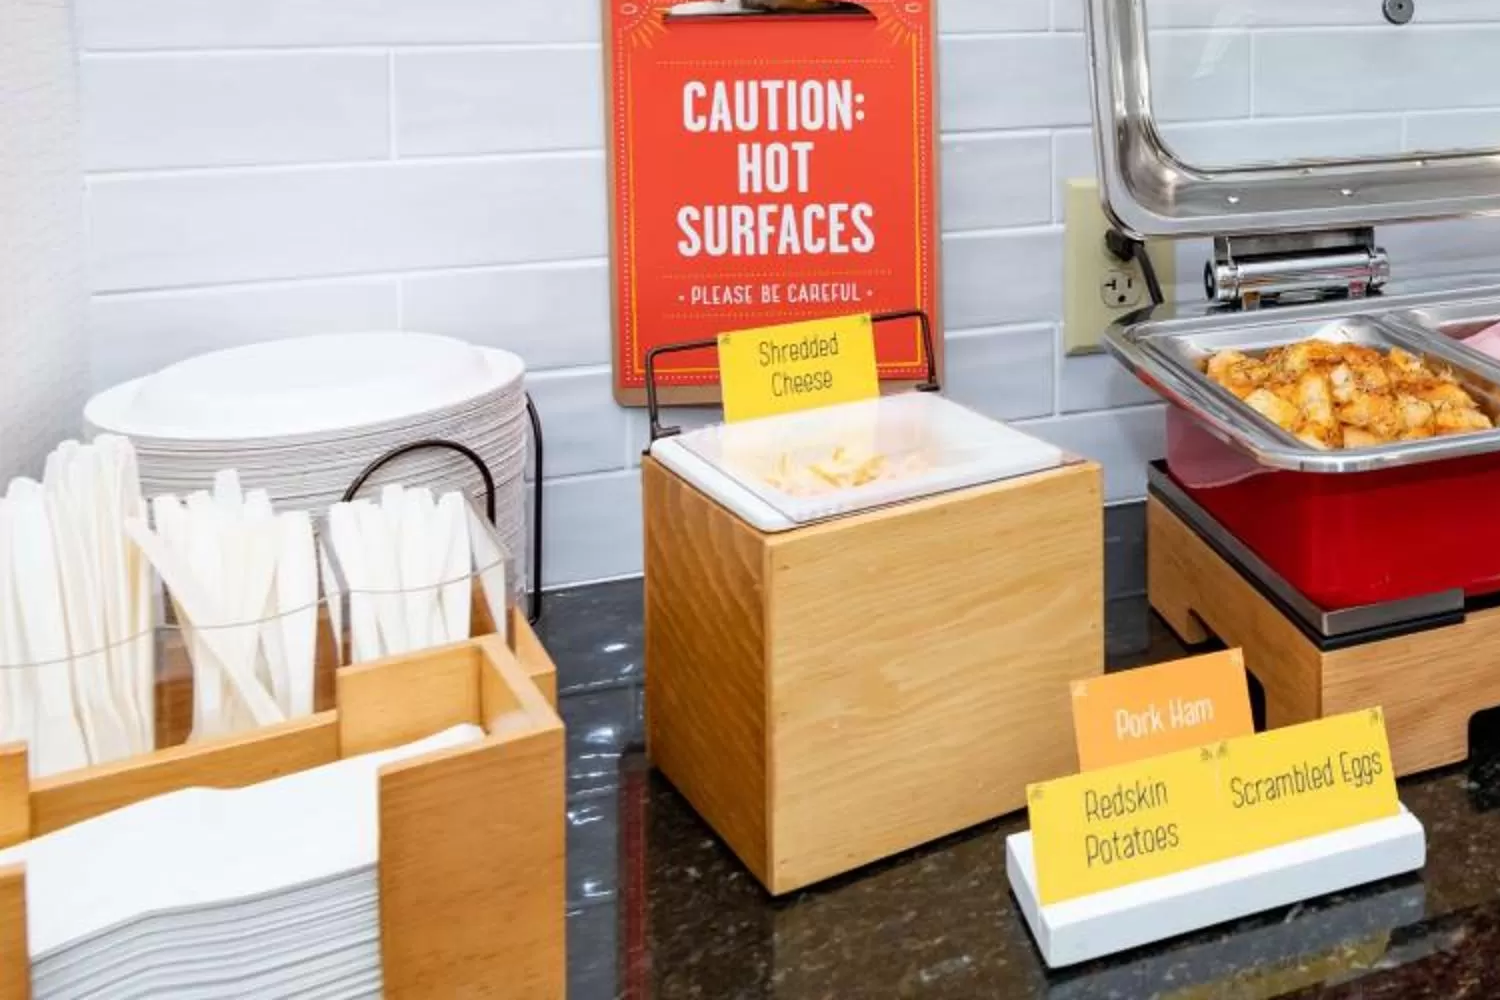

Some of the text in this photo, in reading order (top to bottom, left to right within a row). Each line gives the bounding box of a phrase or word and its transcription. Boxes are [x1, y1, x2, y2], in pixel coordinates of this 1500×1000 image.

[682, 79, 865, 132] CAUTION:
[737, 141, 815, 194] HOT
[676, 202, 876, 257] SURFACES
[691, 281, 861, 305] PLEASE BE CAREFUL
[759, 331, 840, 367] Shredded
[771, 369, 833, 397] Cheese
[1114, 695, 1215, 741] Pork Ham
[1084, 779, 1170, 823] Redskin
[1229, 748, 1383, 810] Scrambled Eggs
[1085, 822, 1180, 869] Potatoes
